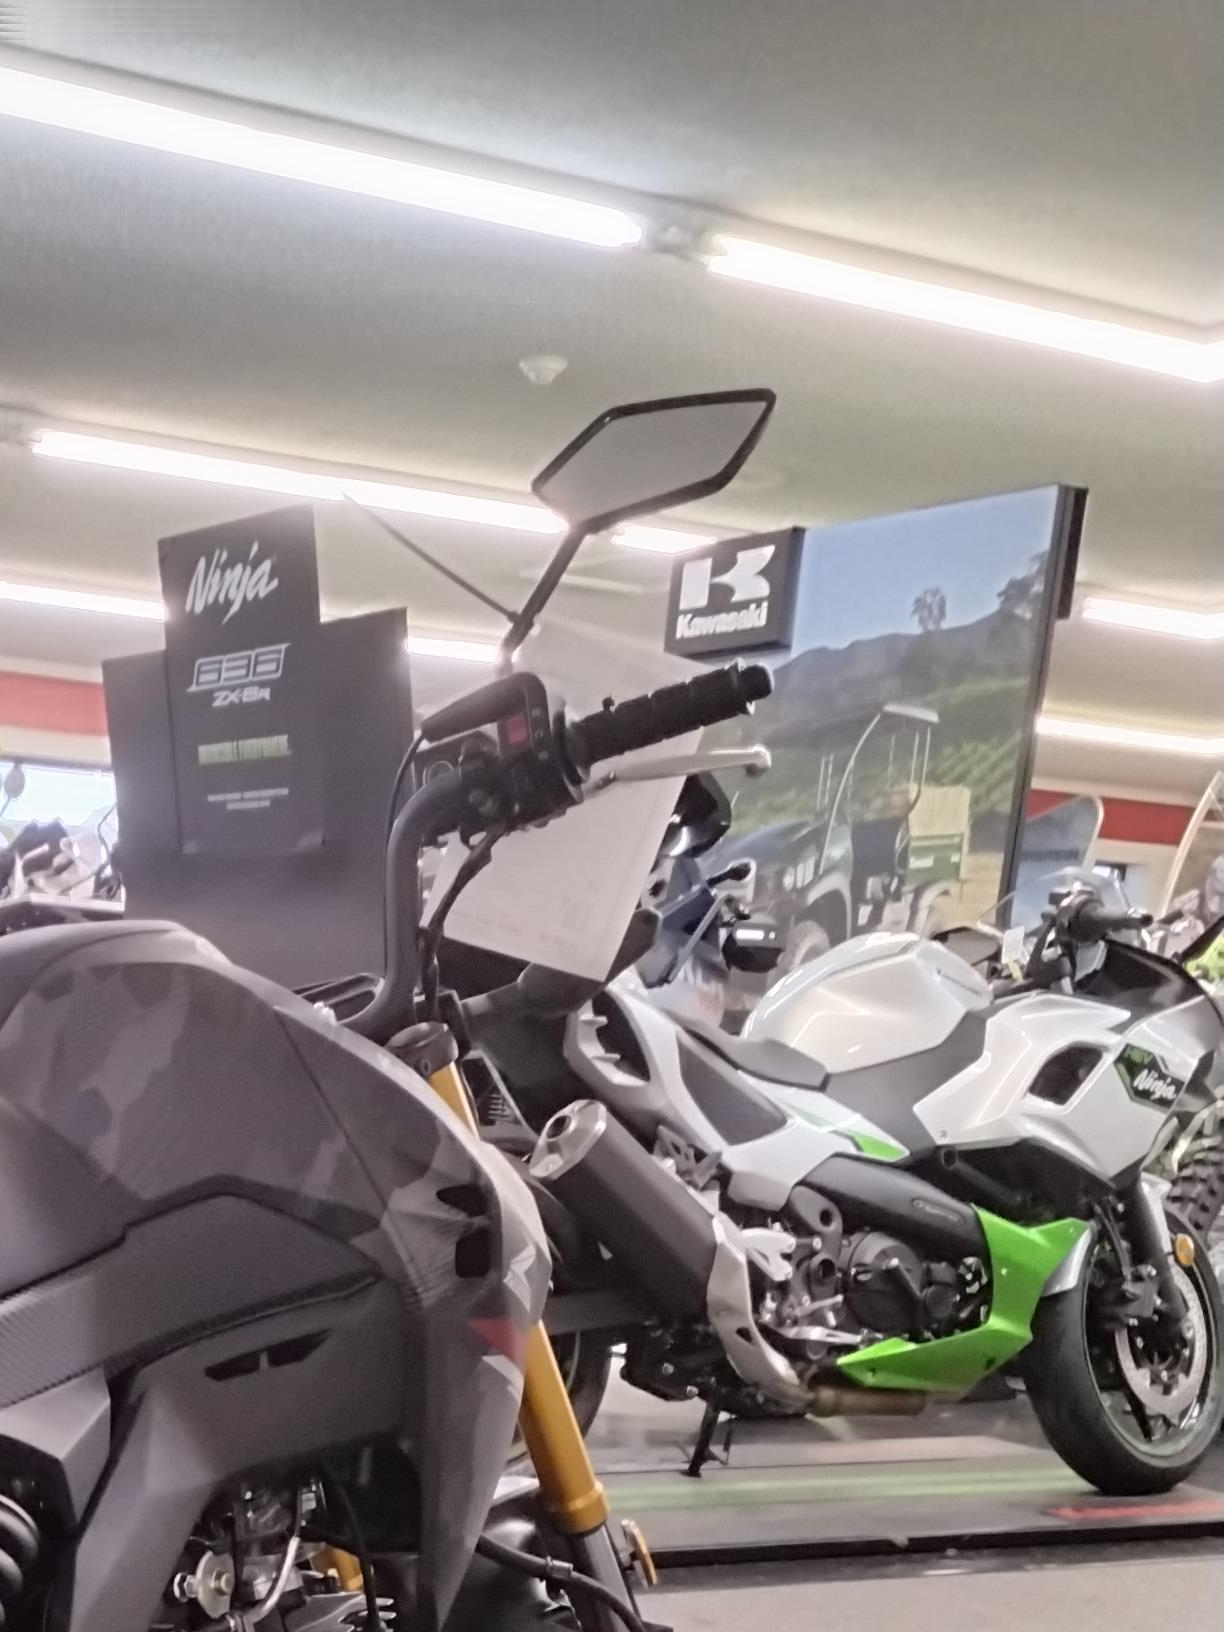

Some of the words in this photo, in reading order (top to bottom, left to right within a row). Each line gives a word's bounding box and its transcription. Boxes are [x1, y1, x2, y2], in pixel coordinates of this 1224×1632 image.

[185, 540, 279, 625] Ninja
[675, 601, 769, 640] Kawasaki
[1133, 1068, 1177, 1100] Ninja
